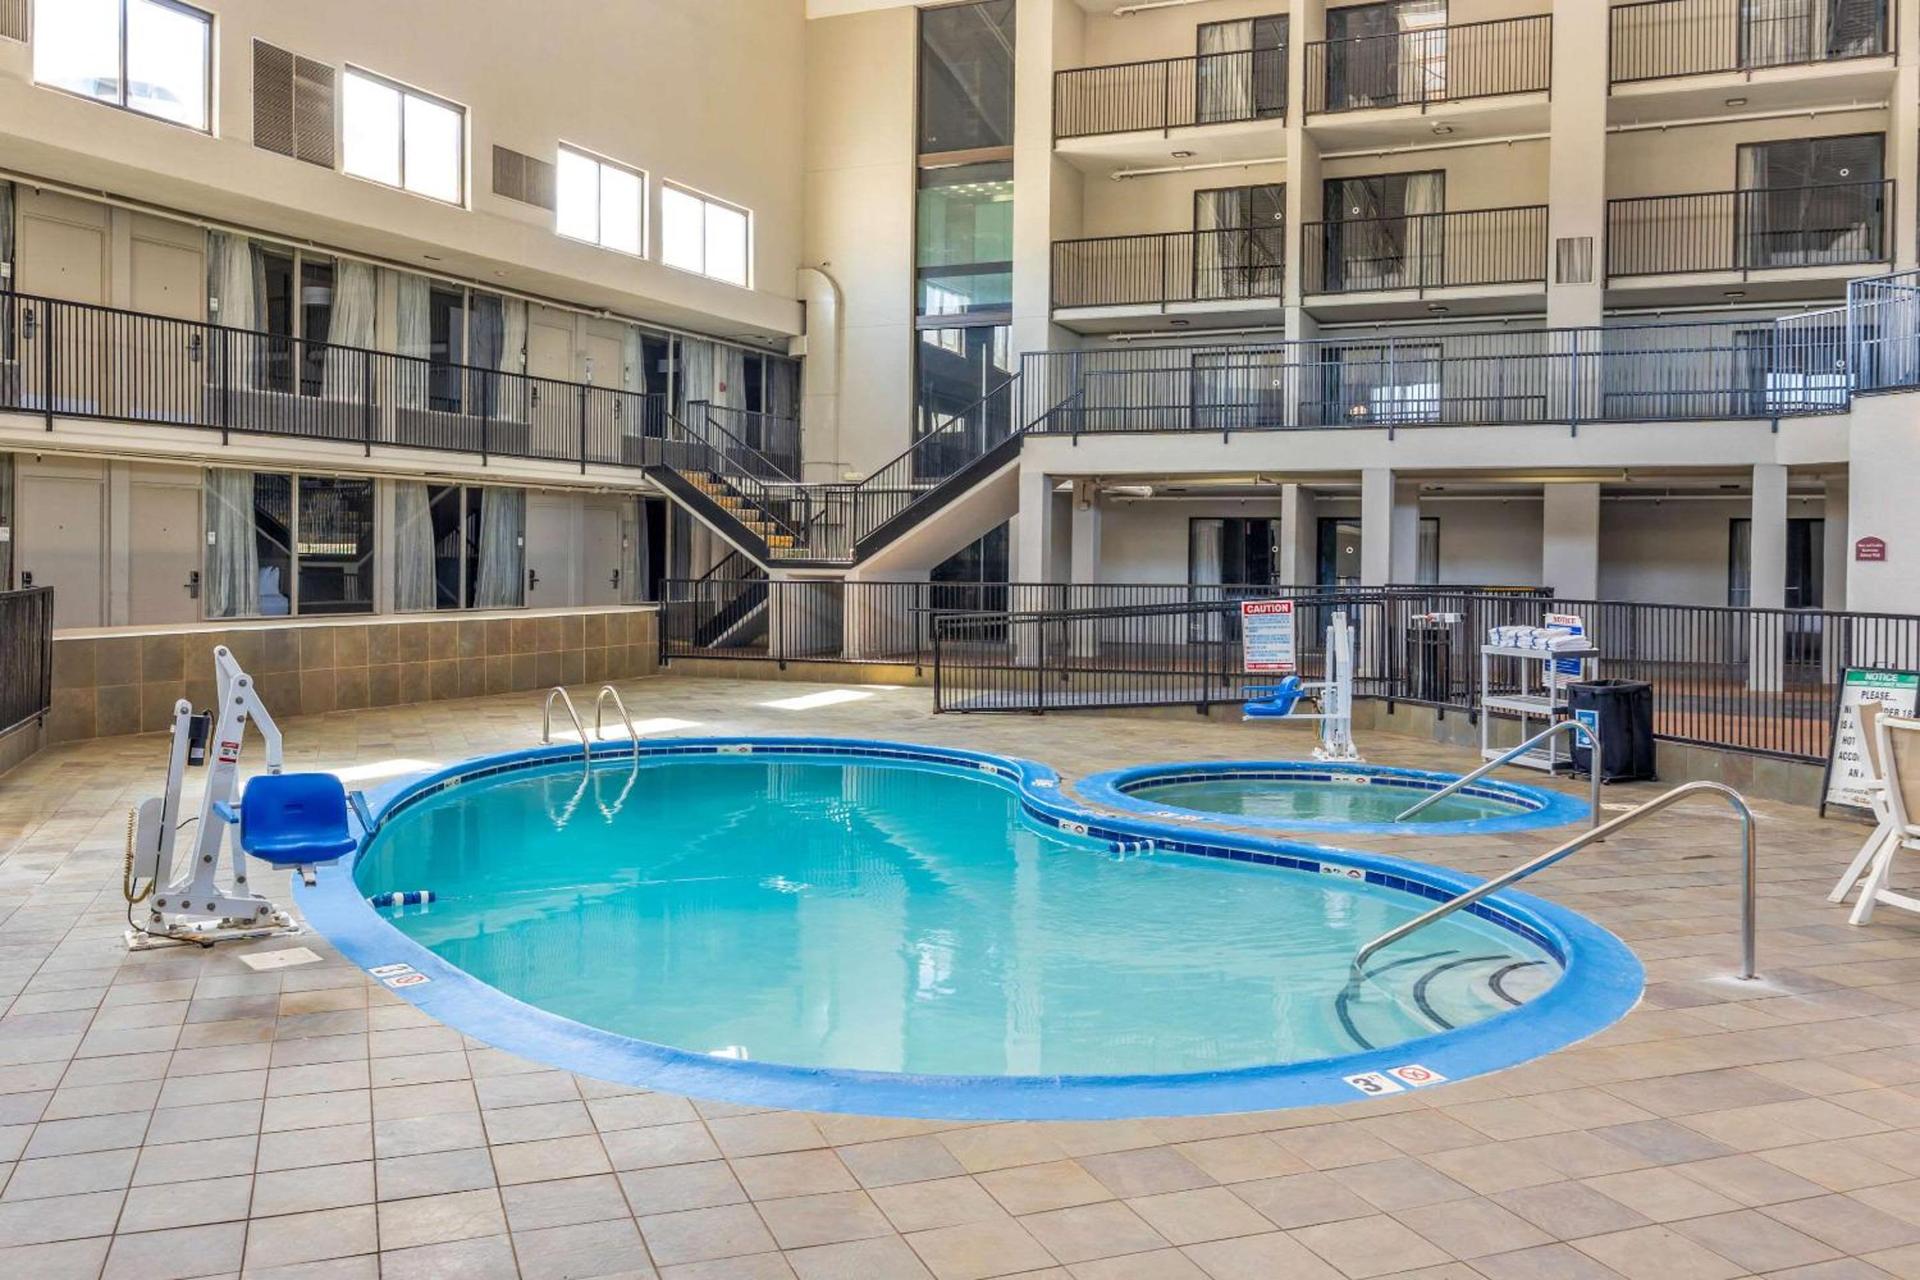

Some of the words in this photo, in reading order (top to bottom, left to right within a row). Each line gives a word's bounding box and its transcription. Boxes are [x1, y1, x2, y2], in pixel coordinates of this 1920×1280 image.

[1247, 604, 1289, 613] CAUTION
[1553, 616, 1577, 624] NOTICE
[1865, 673, 1898, 681] NOTICE
